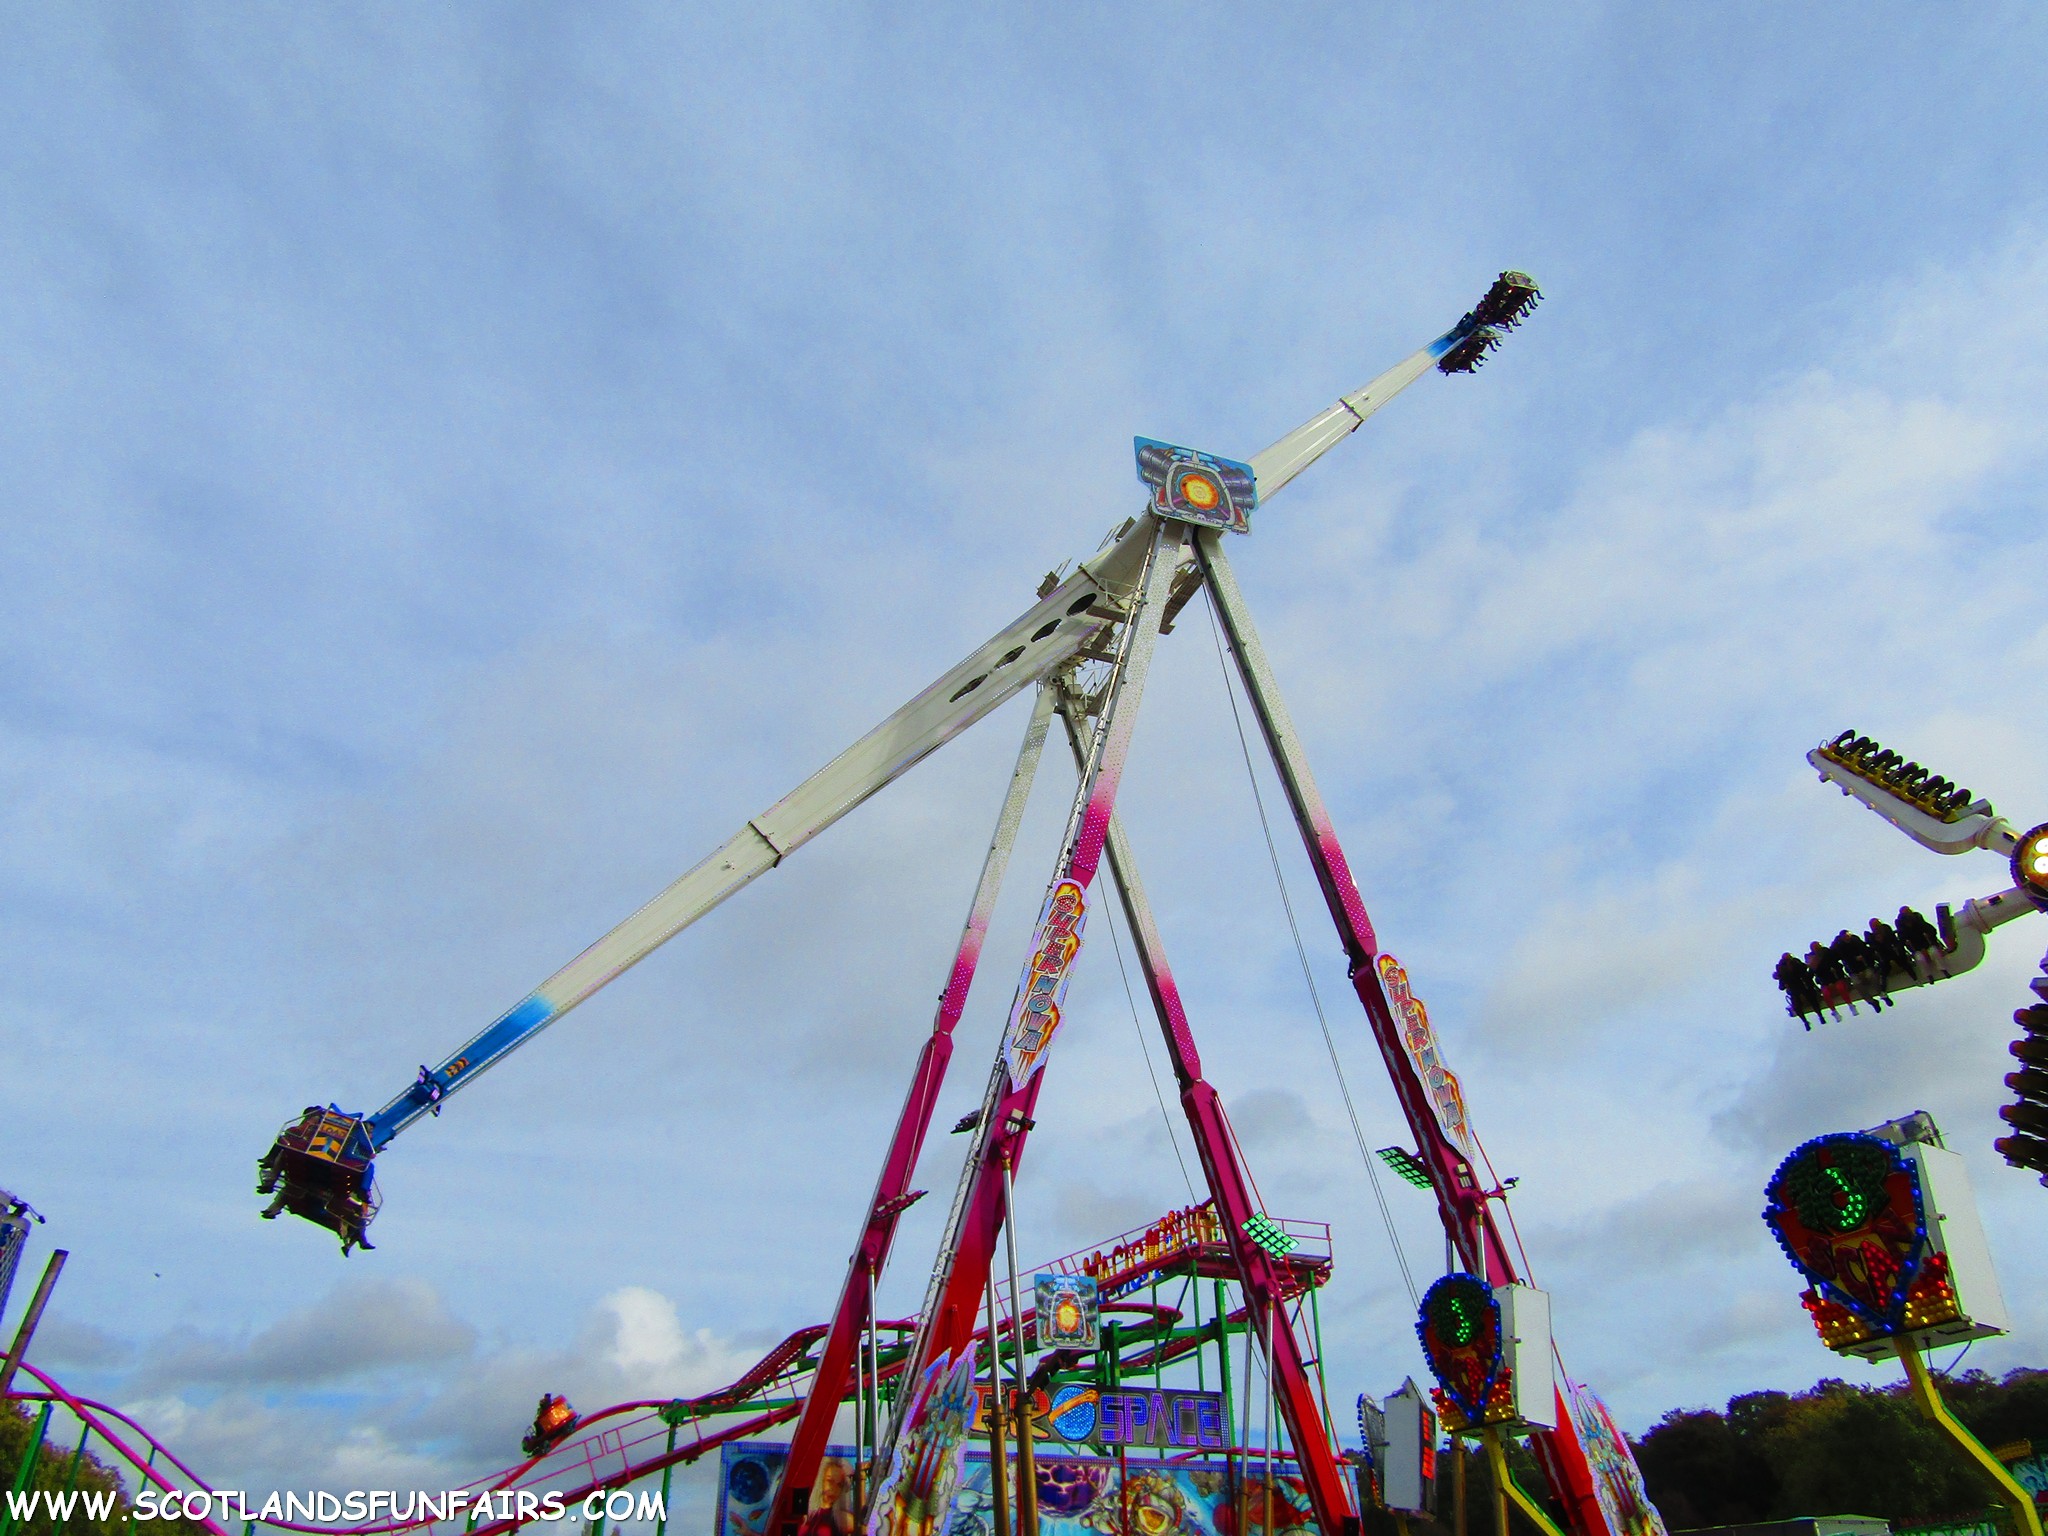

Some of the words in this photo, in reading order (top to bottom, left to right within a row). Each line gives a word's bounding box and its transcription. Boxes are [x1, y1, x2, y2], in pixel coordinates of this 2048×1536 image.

[1014, 894, 1077, 1052] SUPERNOVA
[1384, 965, 1462, 1130] SUPERNOVA
[1099, 1393, 1221, 1447] SPACE
